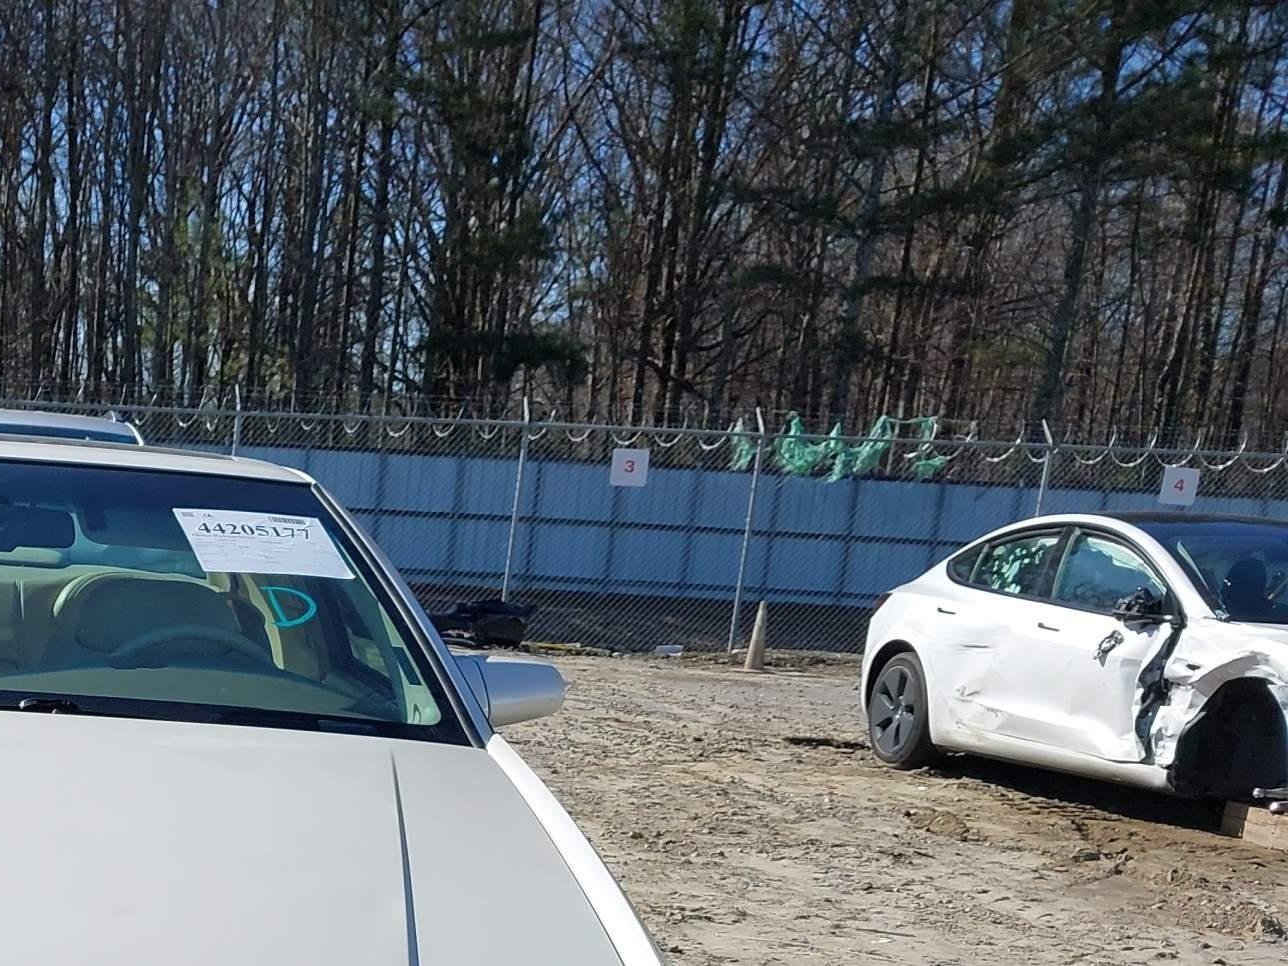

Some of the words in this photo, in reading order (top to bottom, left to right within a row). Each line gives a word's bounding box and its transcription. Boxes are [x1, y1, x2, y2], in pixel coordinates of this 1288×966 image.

[623, 459, 636, 473] 3
[1174, 478, 1185, 492] 4
[196, 521, 310, 540] 44205177
[260, 585, 318, 628] D
